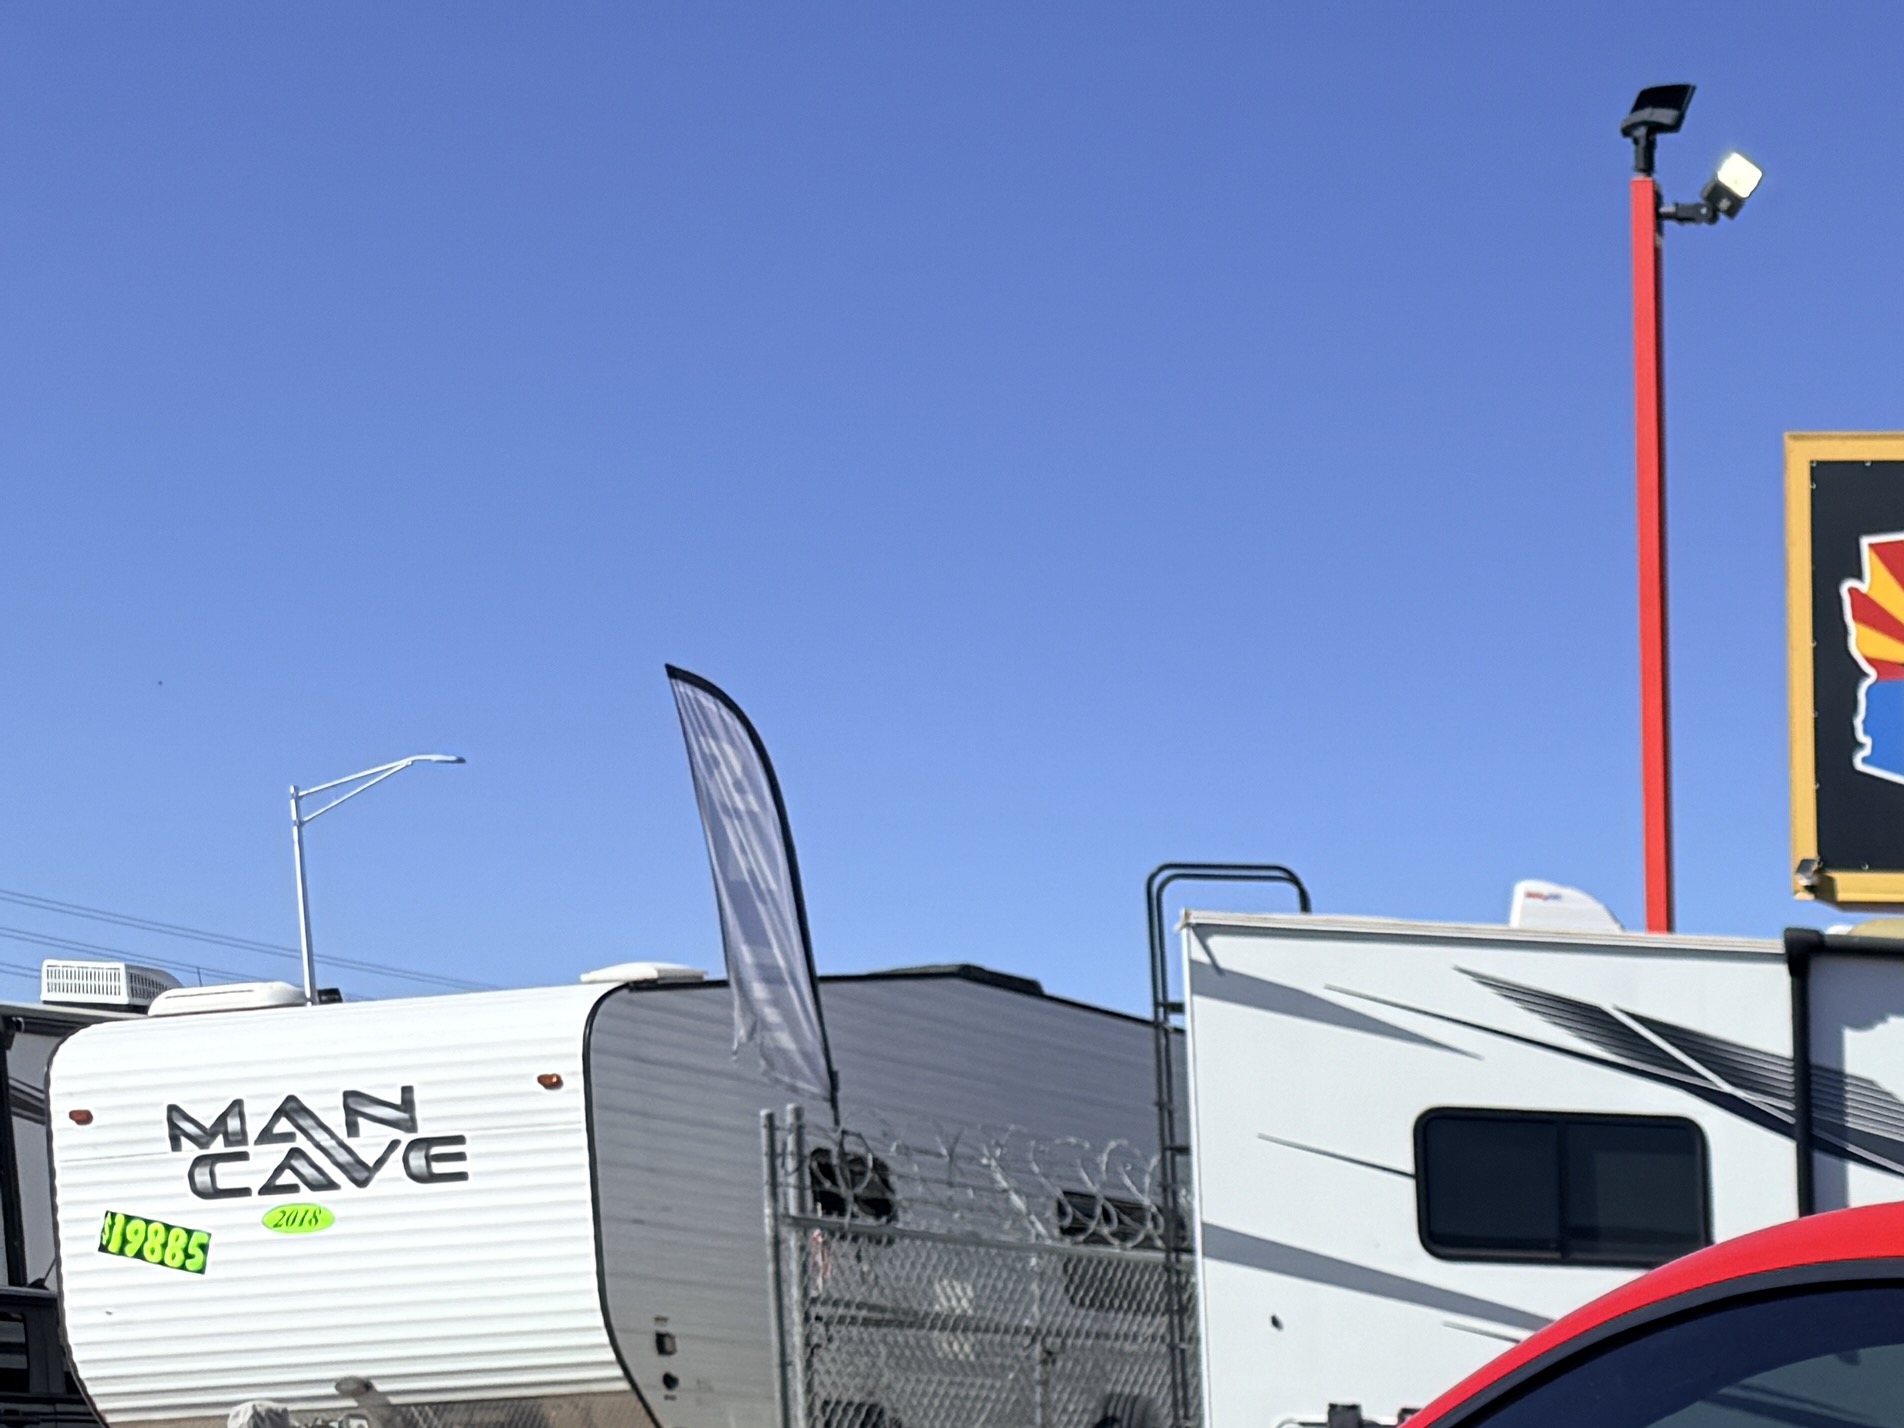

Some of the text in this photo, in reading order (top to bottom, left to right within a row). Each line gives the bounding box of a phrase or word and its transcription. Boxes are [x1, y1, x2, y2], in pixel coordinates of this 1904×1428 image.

[166, 1085, 418, 1153] MAN
[188, 1134, 469, 1200] CAVE
[101, 1211, 210, 1272] $19885
[272, 1206, 324, 1229] 2018
